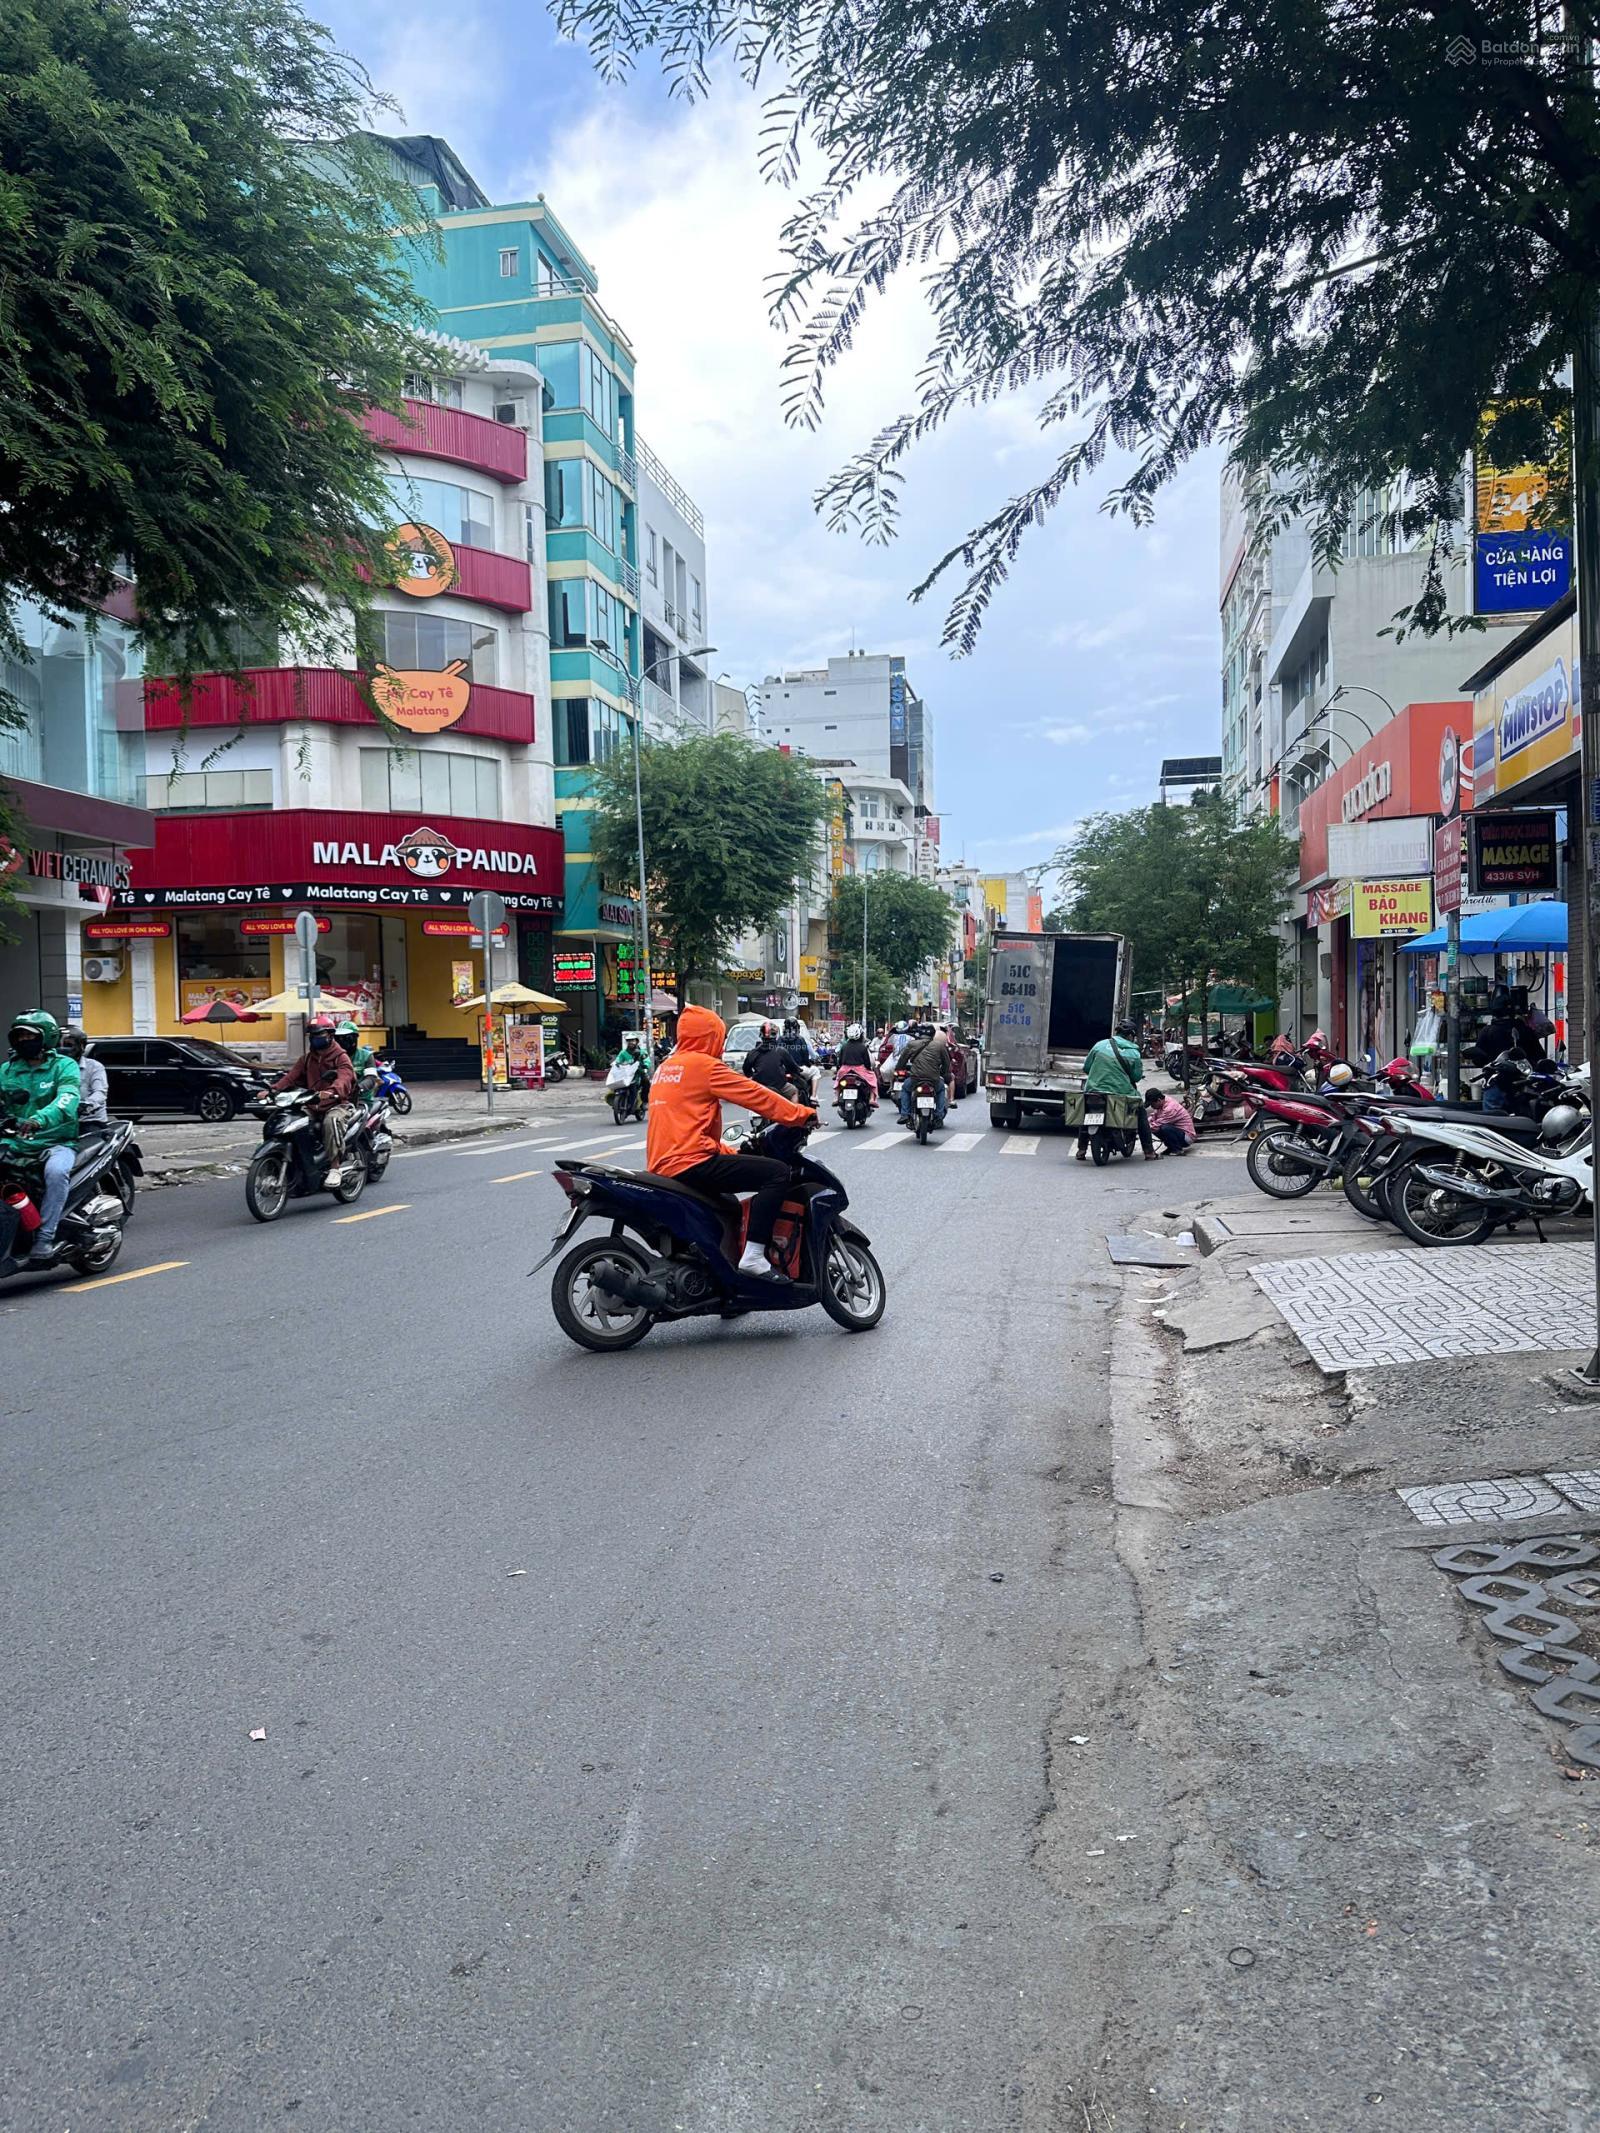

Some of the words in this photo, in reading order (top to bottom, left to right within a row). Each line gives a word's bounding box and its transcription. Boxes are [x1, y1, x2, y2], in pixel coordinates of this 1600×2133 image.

[1493, 569, 1528, 587] TIỆN
[1531, 567, 1556, 586] LỢI
[410, 688, 434, 701] Cay
[438, 686, 454, 698] Tê
[396, 706, 449, 718] Malatang
[1503, 678, 1564, 749] MINISTOP
[313, 841, 400, 867] MALA
[456, 848, 538, 875] PANDA
[1482, 844, 1550, 866] MASSAGE
[32, 849, 131, 889] VIETCERAMICS
[1486, 871, 1514, 881] 433/6
[1517, 870, 1539, 880] SVH
[1362, 883, 1422, 894] MASSAGE
[120, 890, 135, 904] Tê
[165, 889, 225, 904] Malatang
[227, 888, 252, 903] Cay
[254, 886, 271, 899] Tê
[306, 885, 377, 902] Malatang
[380, 887, 409, 903] Cay
[412, 888, 429, 901] Tê
[519, 895, 540, 910] Cay
[541, 896, 553, 908] Tê
[1369, 894, 1397, 910] BẢO
[1379, 911, 1428, 925] KHANG
[1009, 965, 1031, 978] 51C
[1001, 983, 1036, 997] 85418
[1007, 1003, 1025, 1013] 51C
[540, 1015, 558, 1023] Grab
[658, 1072, 682, 1083] Food
